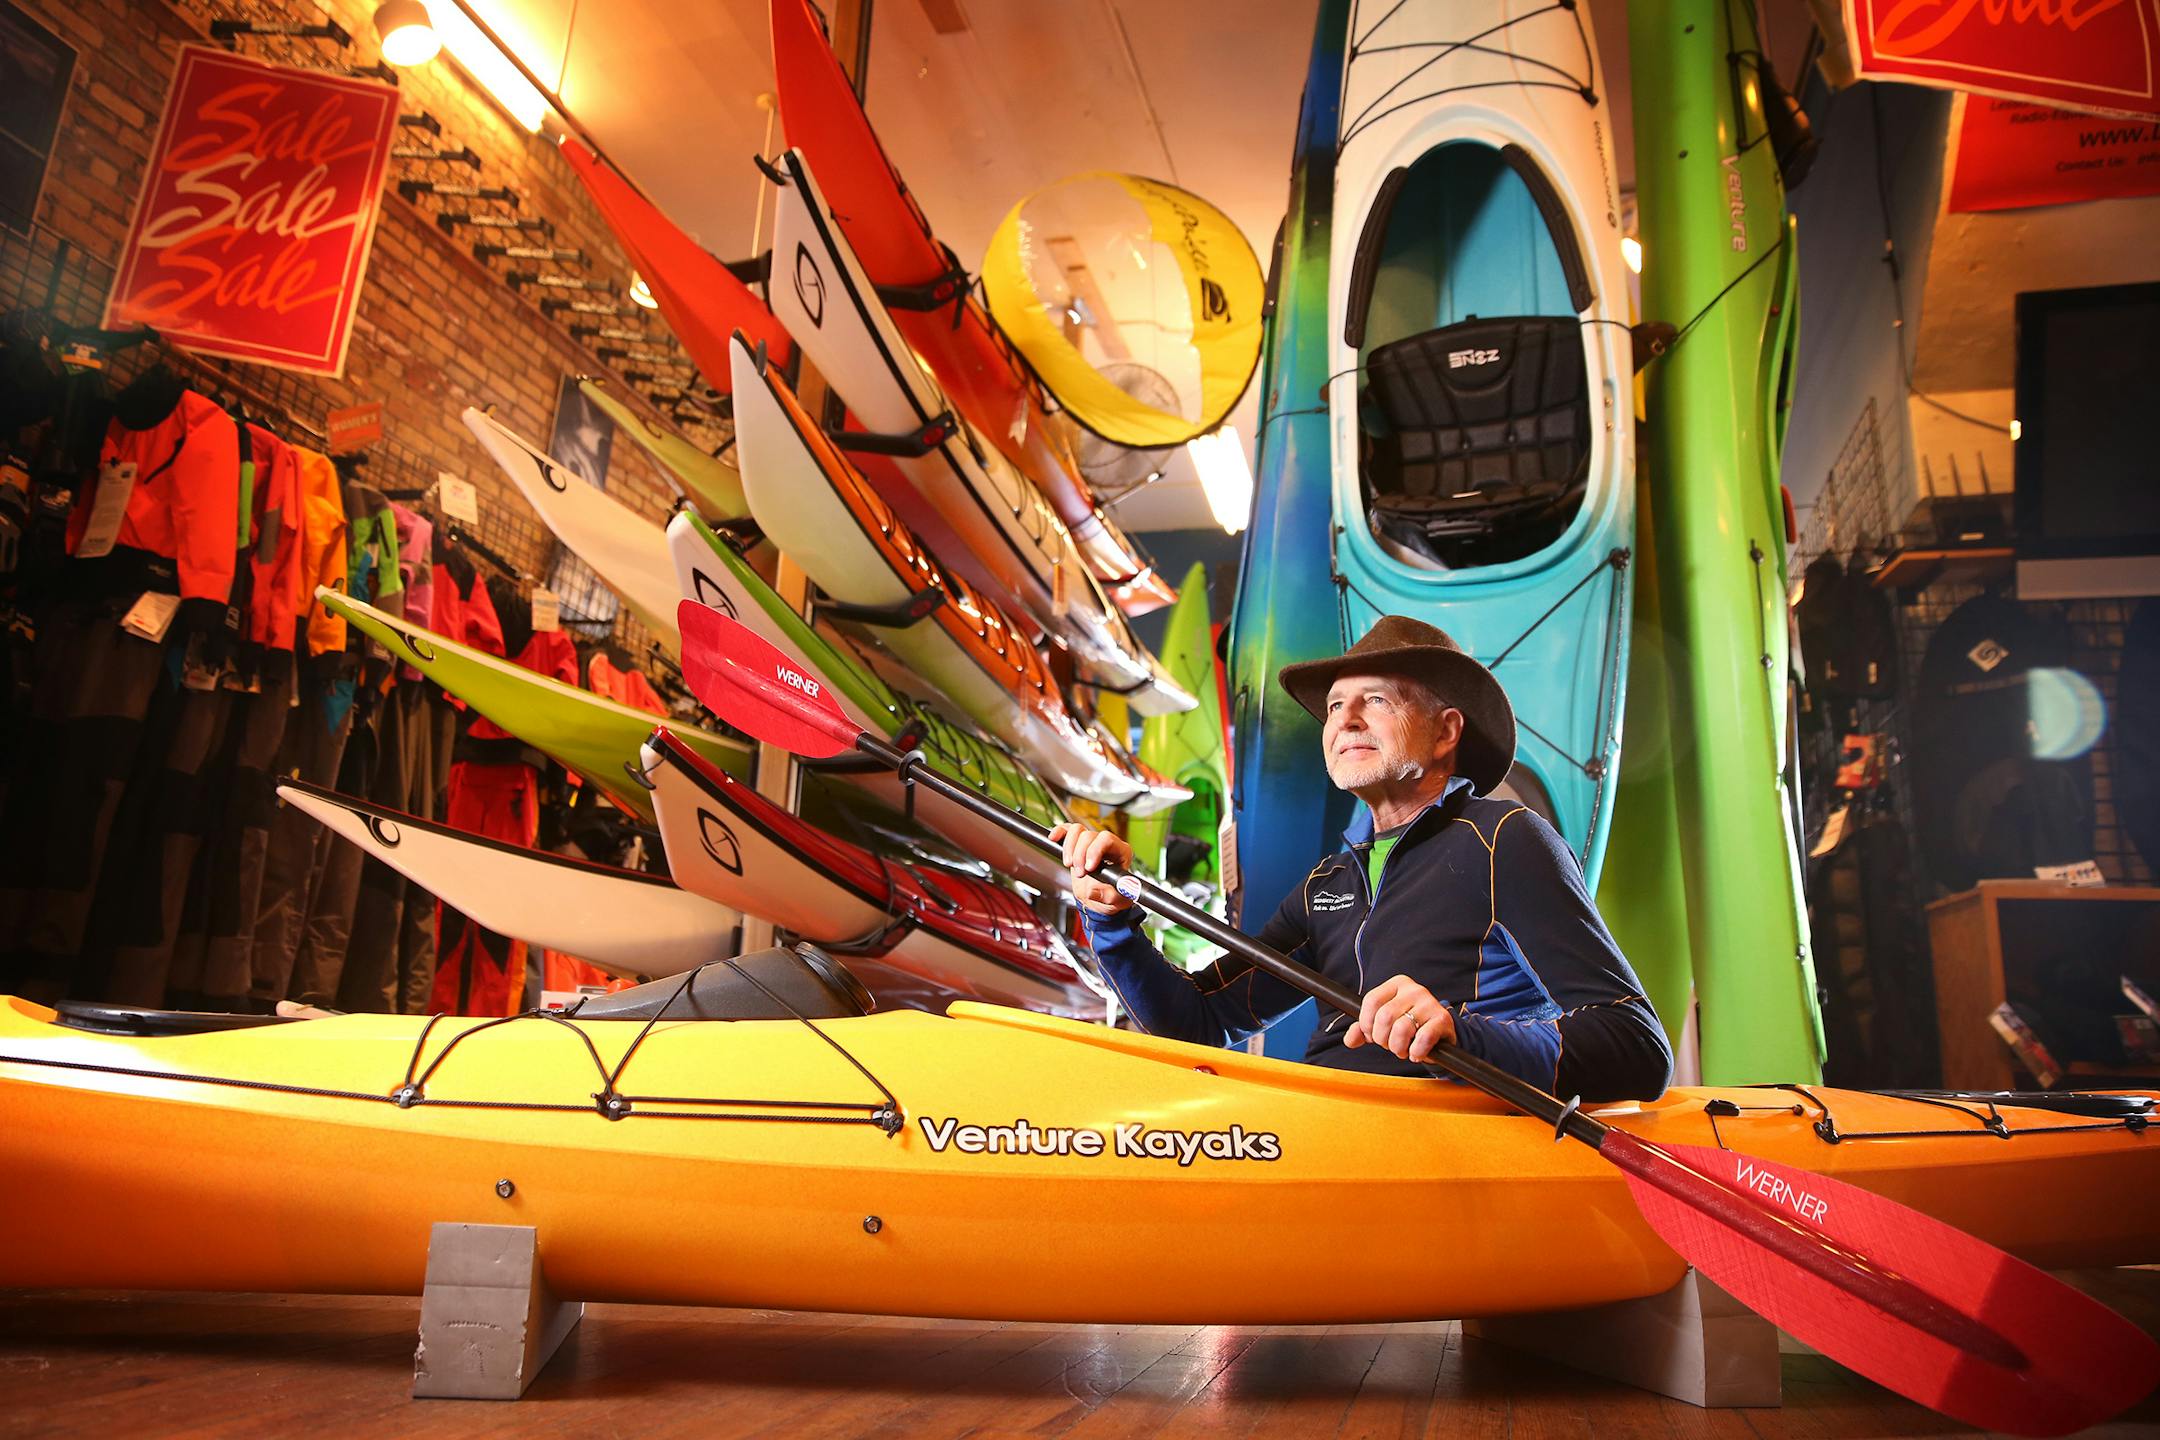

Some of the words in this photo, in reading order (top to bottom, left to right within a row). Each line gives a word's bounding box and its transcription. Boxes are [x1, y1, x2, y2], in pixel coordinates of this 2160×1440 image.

[161, 83, 377, 171] Sale
[139, 152, 371, 247] Sale
[1722, 154, 1746, 252] Venture
[118, 224, 343, 321] Sale
[776, 664, 819, 698] WERNER
[919, 1118, 1106, 1157] Venture
[1114, 1123, 1283, 1167] Kayaks
[1737, 1158, 1828, 1225] WERNER
